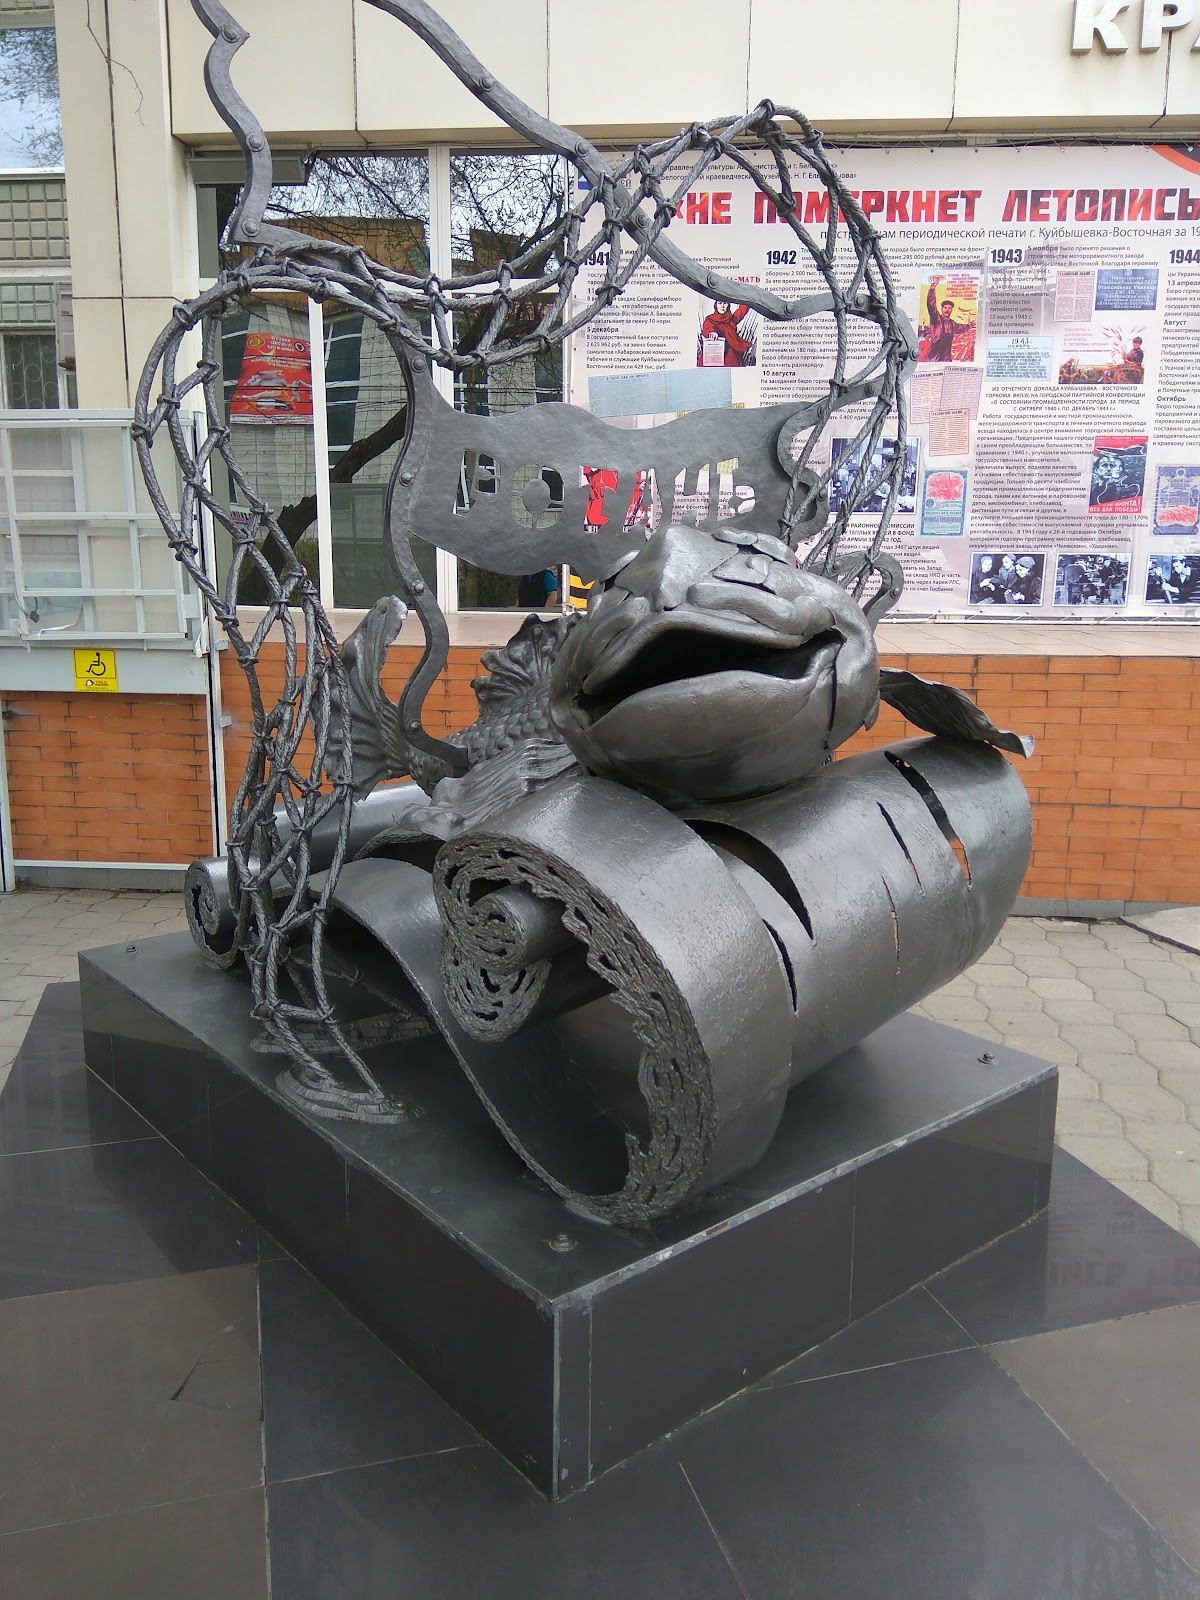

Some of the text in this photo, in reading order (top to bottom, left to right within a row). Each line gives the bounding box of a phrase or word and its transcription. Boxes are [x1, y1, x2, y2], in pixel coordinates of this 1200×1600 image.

[1071, 0, 1200, 54] КР
[753, 190, 983, 225] ПОМРКНЕТ
[1002, 187, 1200, 223] ЛЕТОПИСЬ
[899, 228, 986, 241] периодической
[988, 229, 1026, 239] печати
[1029, 230, 1036, 238] г.
[1039, 226, 1171, 241] Куйбышевка-Восточная
[1175, 228, 1187, 237] за
[584, 251, 610, 266] 1941
[766, 250, 797, 265] 1942
[991, 248, 1023, 264] 1943
[1169, 249, 1200, 264] 1944
[591, 326, 619, 334] декабря
[1164, 319, 1187, 327] Август
[1156, 395, 1186, 403] Октябрь
[452, 449, 756, 538] РОТАНЬ
